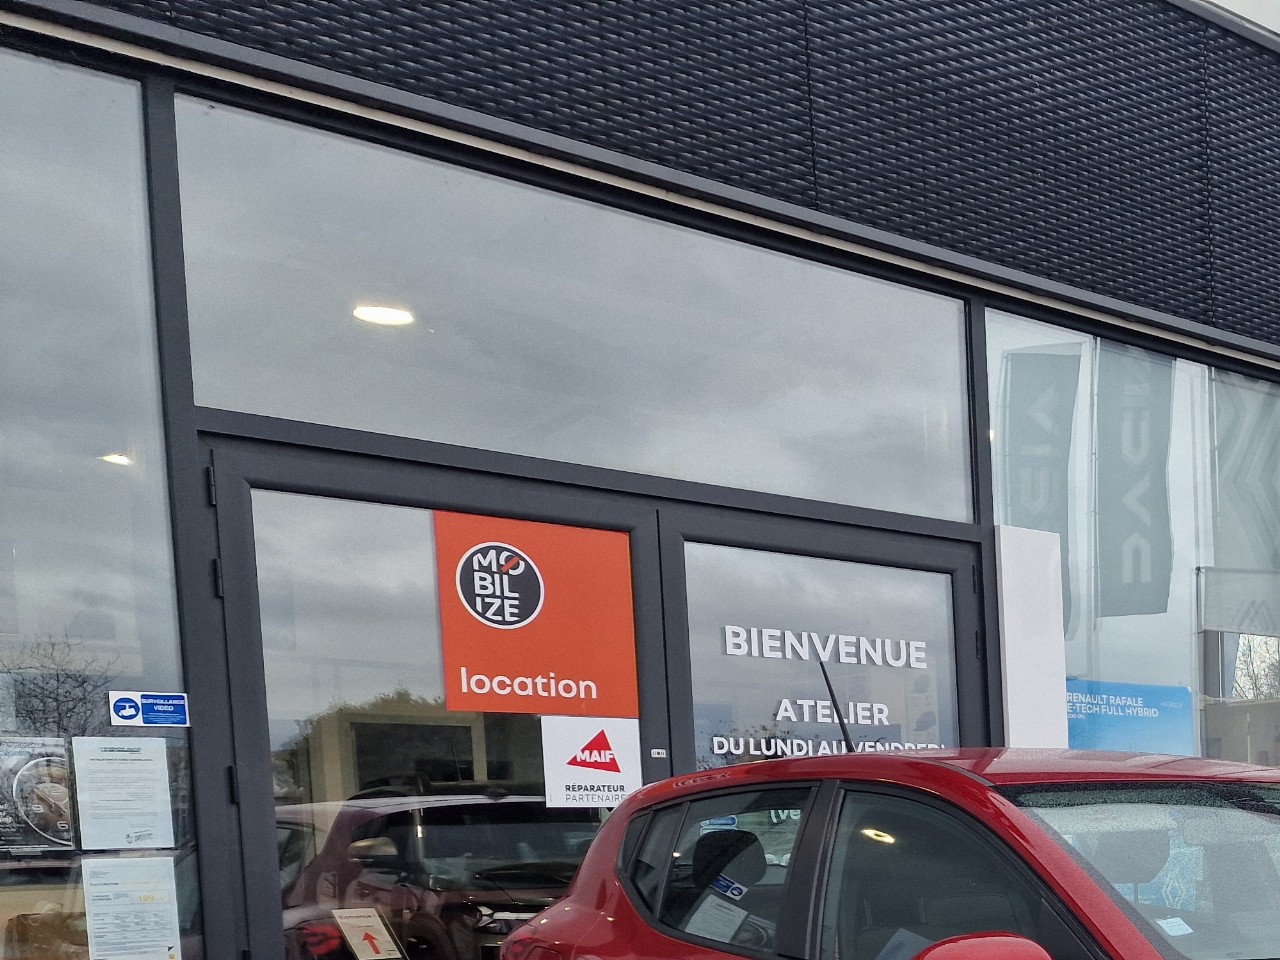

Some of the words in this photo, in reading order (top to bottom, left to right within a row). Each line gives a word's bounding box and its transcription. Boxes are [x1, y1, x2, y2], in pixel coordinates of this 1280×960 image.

[725, 625, 927, 669] BIENVENUE
[460, 666, 598, 699] location
[1066, 692, 1108, 703] RENAULT
[1110, 695, 1144, 707] RAFALE
[1067, 703, 1100, 714] E-TECH
[1101, 706, 1124, 716] FULL
[1125, 707, 1159, 718] HYBRID
[712, 736, 745, 755] DU
[749, 738, 813, 756] LUNDI
[817, 740, 848, 755] AU
[576, 749, 615, 763] MAIF
[564, 783, 626, 793] RÉPARATEUR
